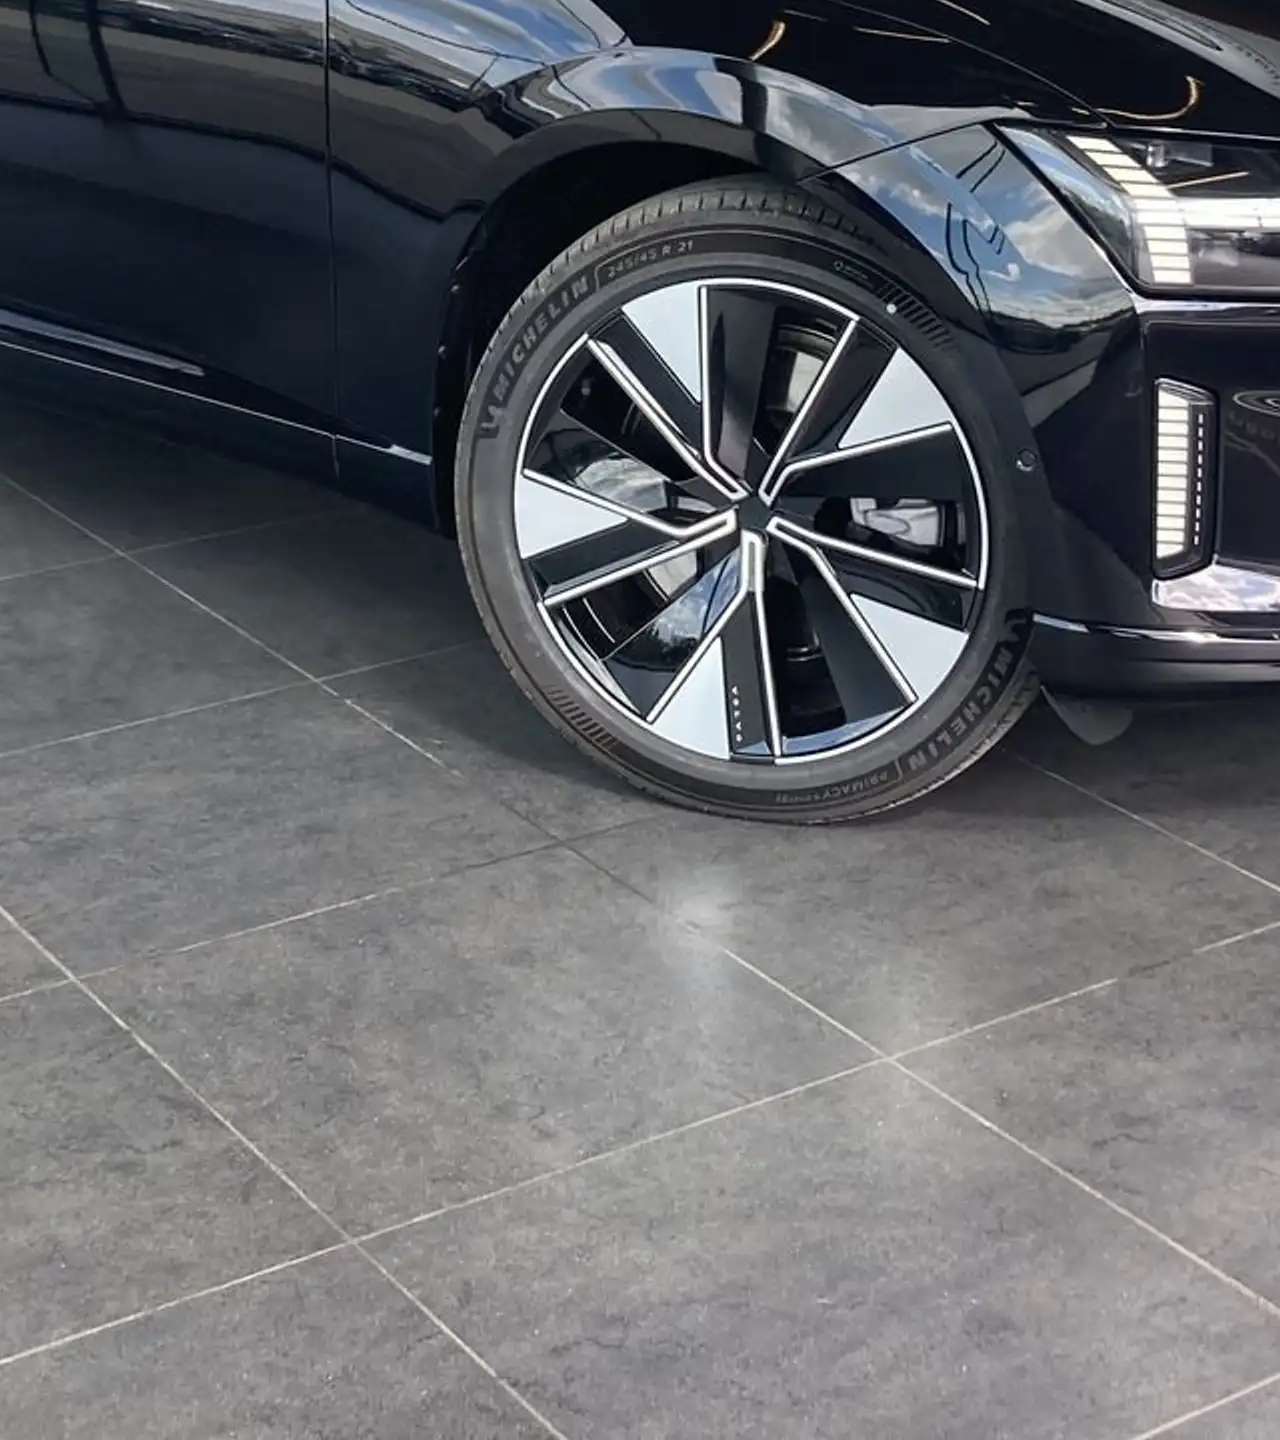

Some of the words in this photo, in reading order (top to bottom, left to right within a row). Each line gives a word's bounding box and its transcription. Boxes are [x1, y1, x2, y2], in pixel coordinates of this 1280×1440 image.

[493, 275, 590, 401] MICHELIN
[909, 647, 1014, 770] MICHELIN
[822, 772, 888, 800] PRIMACY
